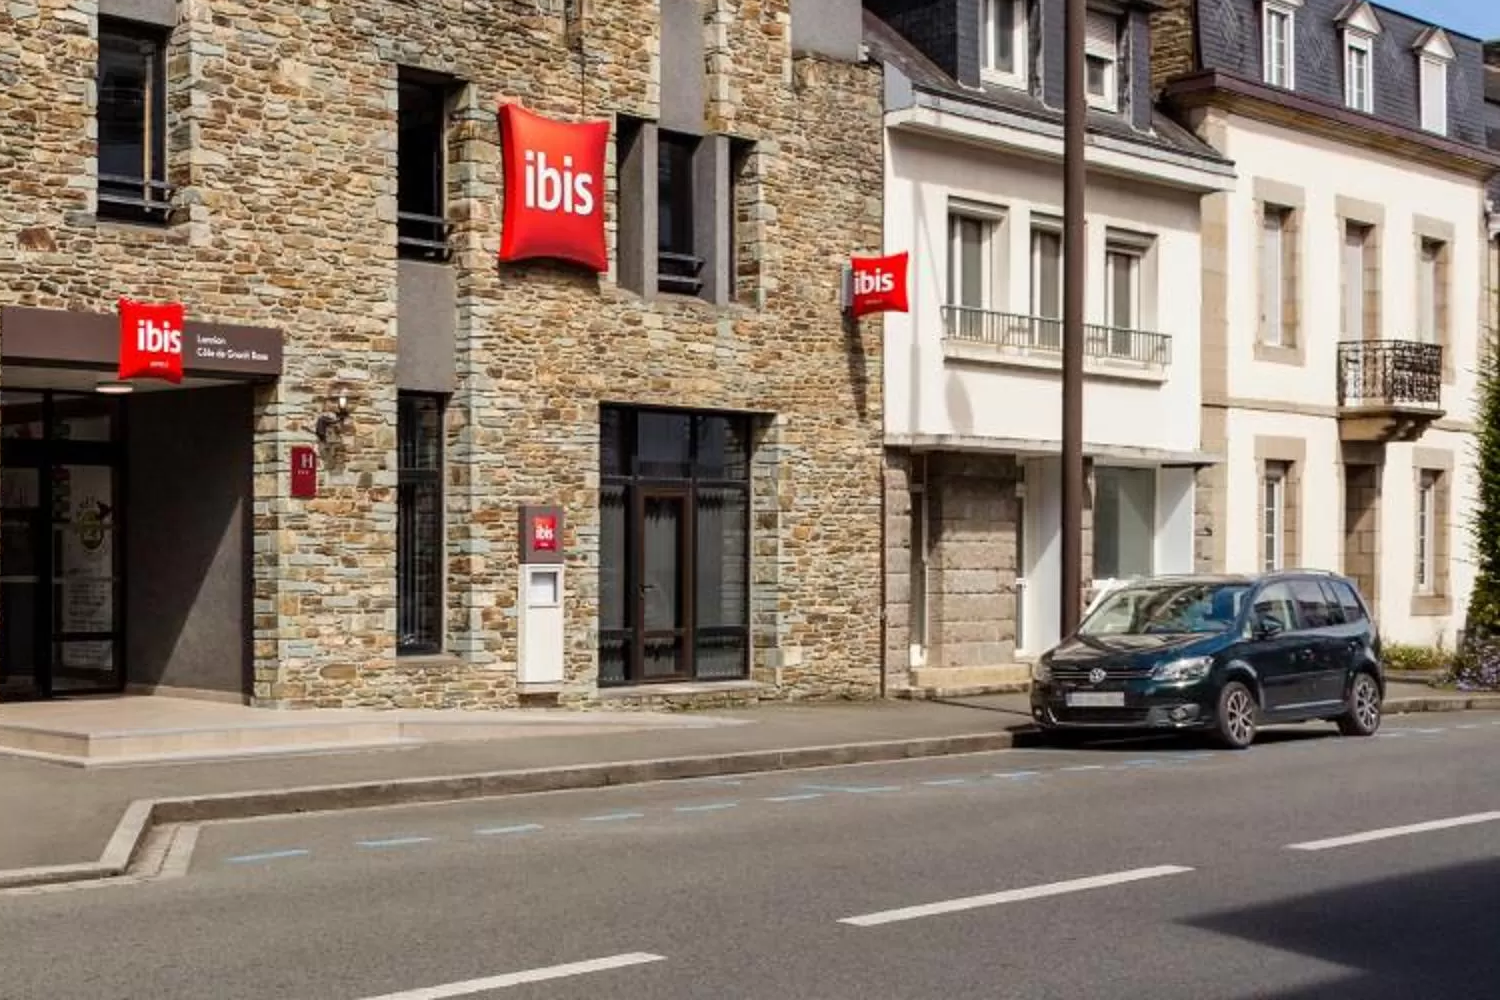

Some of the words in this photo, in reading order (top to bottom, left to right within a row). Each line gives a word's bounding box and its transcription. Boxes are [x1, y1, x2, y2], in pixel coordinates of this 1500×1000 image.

[524, 150, 594, 215] ibis
[853, 267, 895, 295] ibis
[137, 319, 182, 354] ibis
[535, 524, 553, 540] ibis
